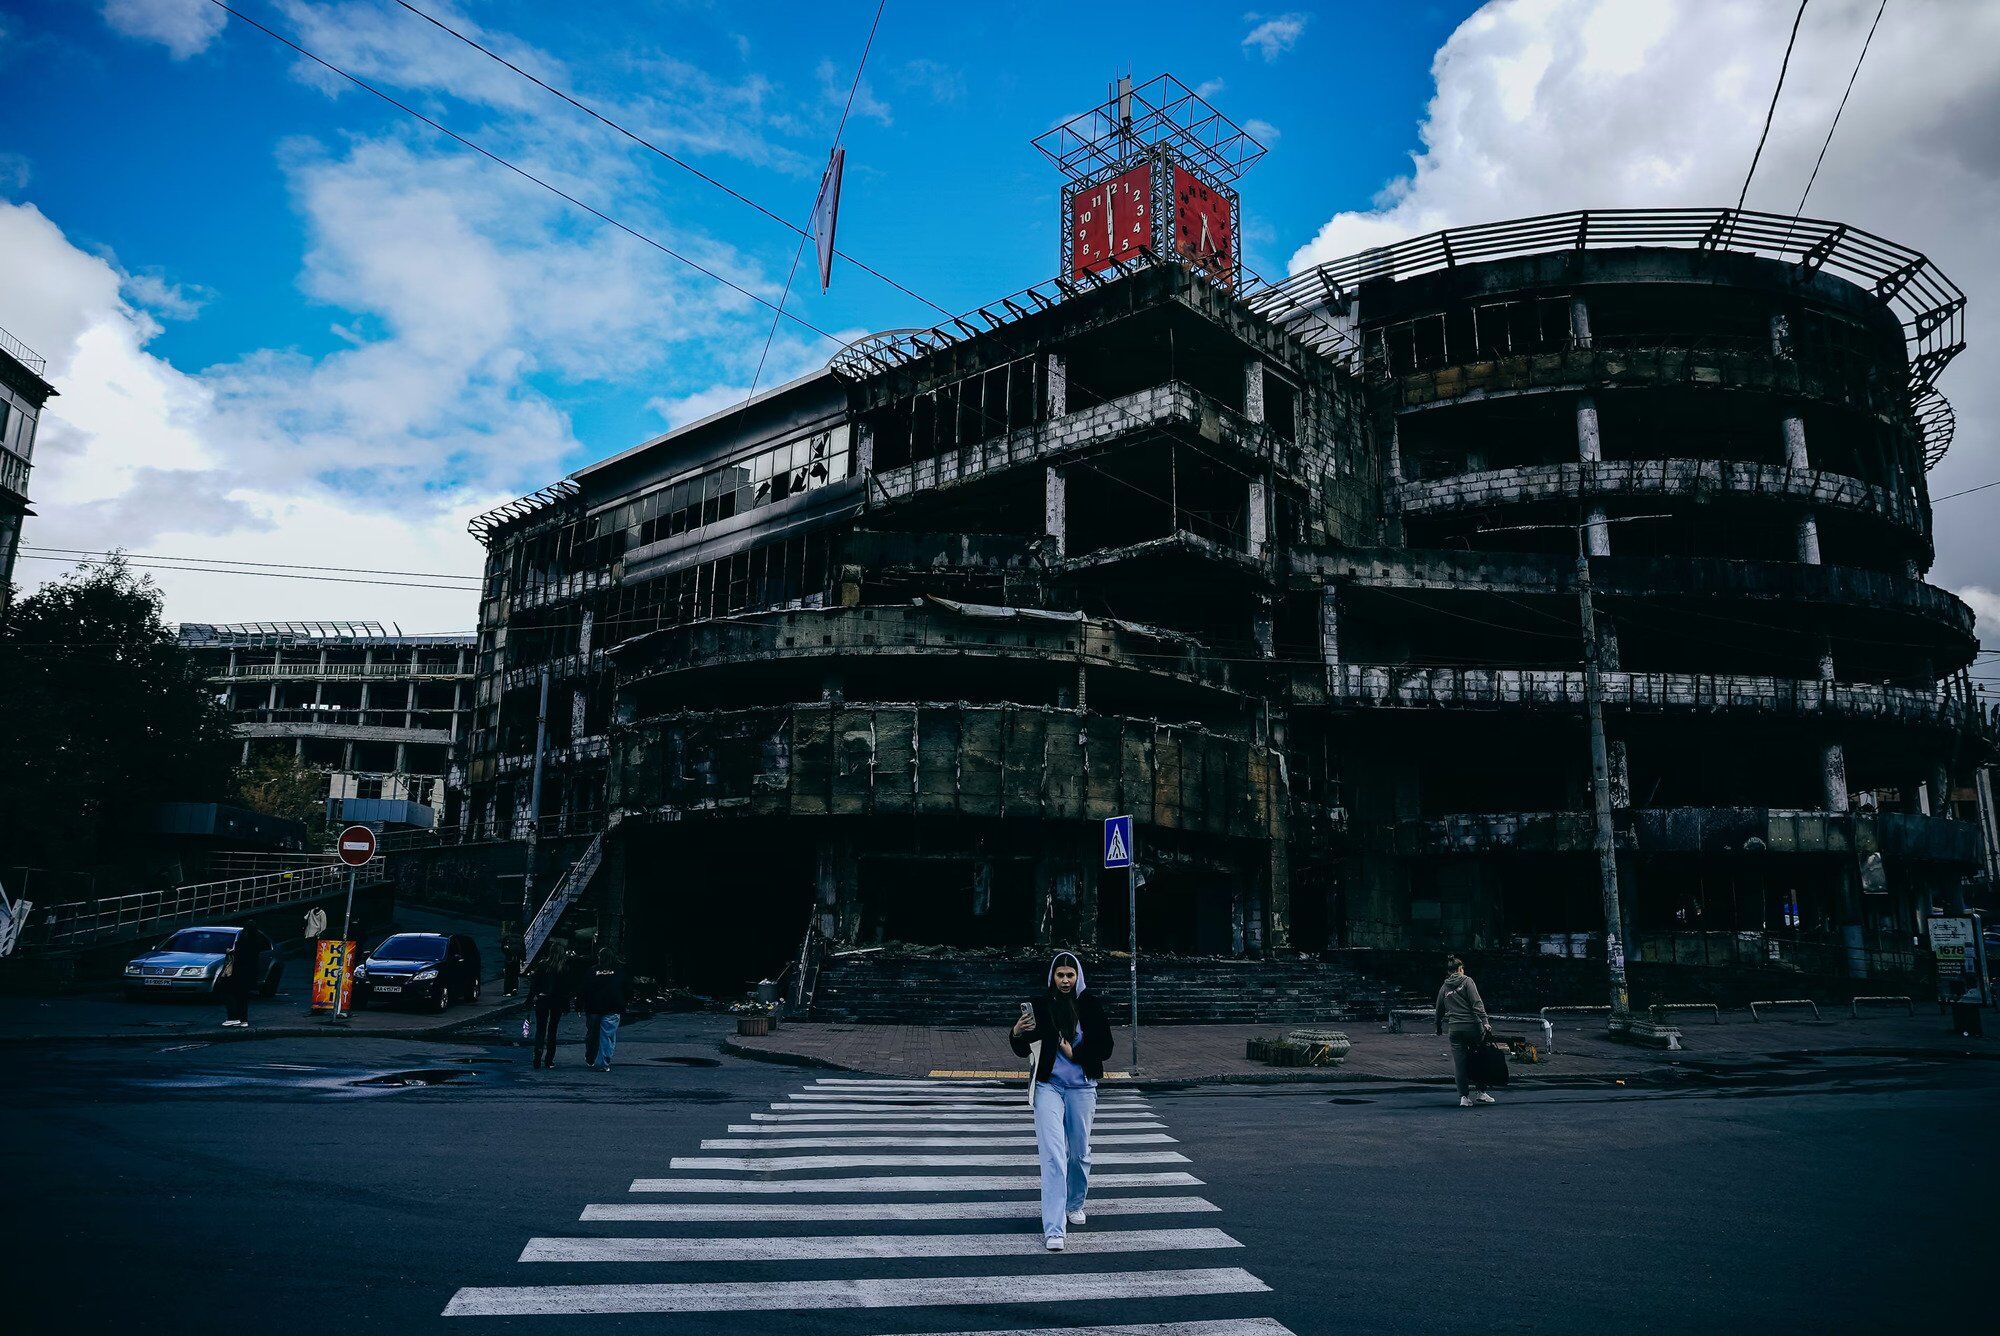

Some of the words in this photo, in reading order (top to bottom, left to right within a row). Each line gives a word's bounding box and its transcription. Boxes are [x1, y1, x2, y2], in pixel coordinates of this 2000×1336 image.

[1124, 183, 1129, 194] 1
[1091, 195, 1101, 208] 11
[1133, 189, 1141, 202] 2
[1136, 204, 1144, 216] 3
[1080, 211, 1091, 224] 10
[1133, 222, 1141, 234] 4
[1080, 230, 1086, 241] 9
[1083, 244, 1090, 255] 8
[1122, 239, 1129, 251] 5
